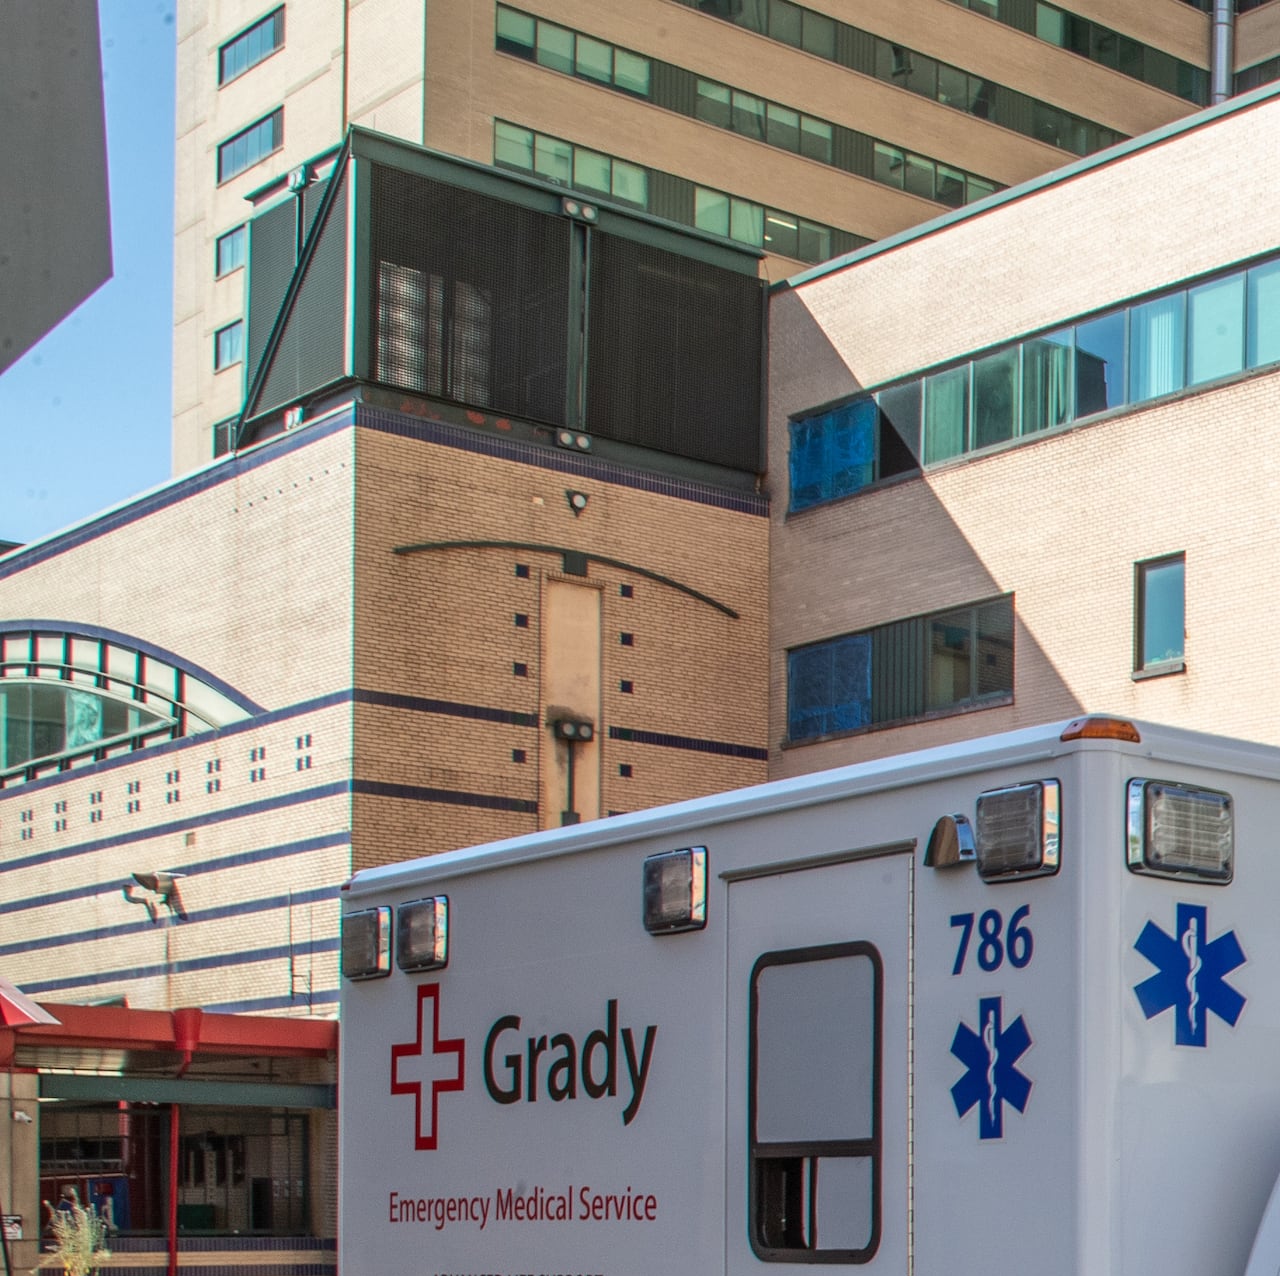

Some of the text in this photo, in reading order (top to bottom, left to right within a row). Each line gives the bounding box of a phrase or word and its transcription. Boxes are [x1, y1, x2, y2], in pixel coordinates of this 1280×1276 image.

[949, 904, 1034, 976] 786
[483, 999, 658, 1126] Grady
[388, 1185, 658, 1231] Emergency Medical Service
